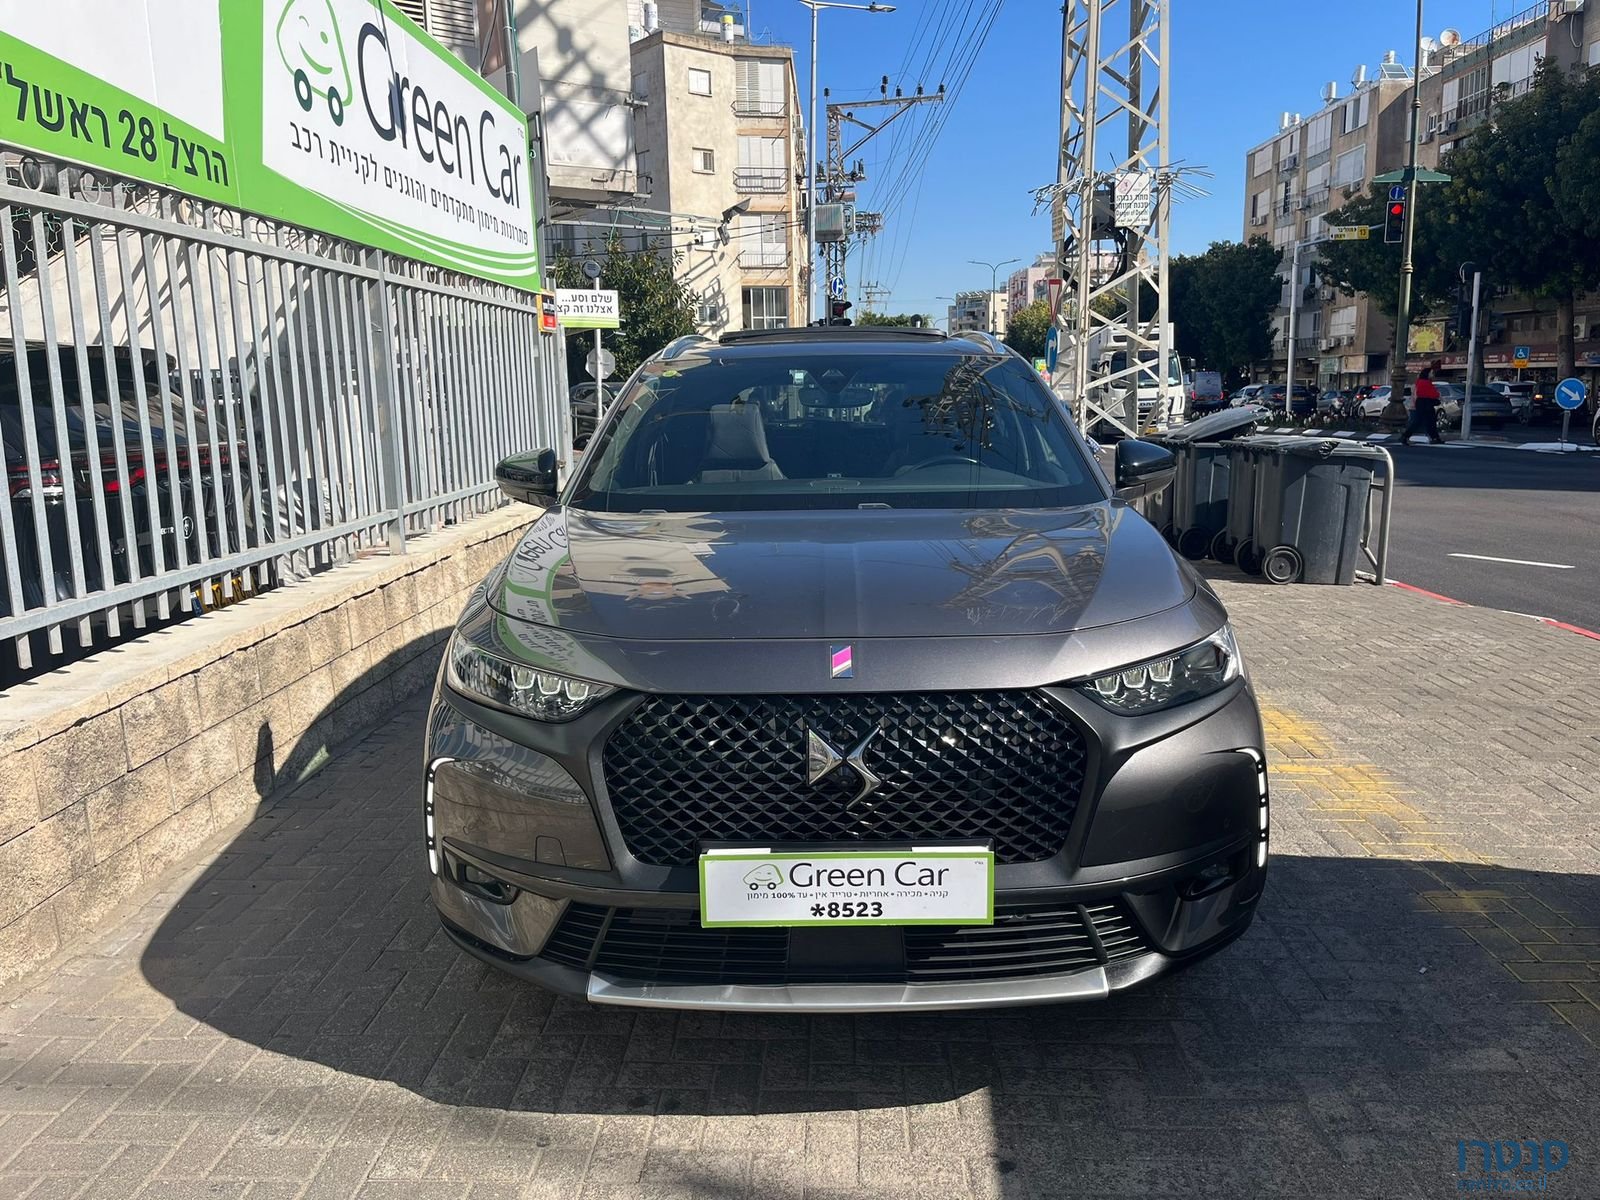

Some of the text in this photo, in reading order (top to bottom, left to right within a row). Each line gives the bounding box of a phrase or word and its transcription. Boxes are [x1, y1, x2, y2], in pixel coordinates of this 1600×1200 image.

[357, 22, 520, 209] Green Car
[0, 61, 229, 187] הרצל 28 ראשל
[289, 121, 528, 246] פתרונות מימון מתקדמים והוגנים לקניית רכב
[591, 294, 613, 303] שלם
[557, 304, 613, 315] אצלנו זה קצ
[789, 861, 950, 888] Green Car
[747, 892, 769, 900] מימון
[815, 891, 828, 900] אין
[859, 890, 889, 898] אחריות
[896, 890, 922, 898] מכירה
[929, 890, 949, 898] קניה
